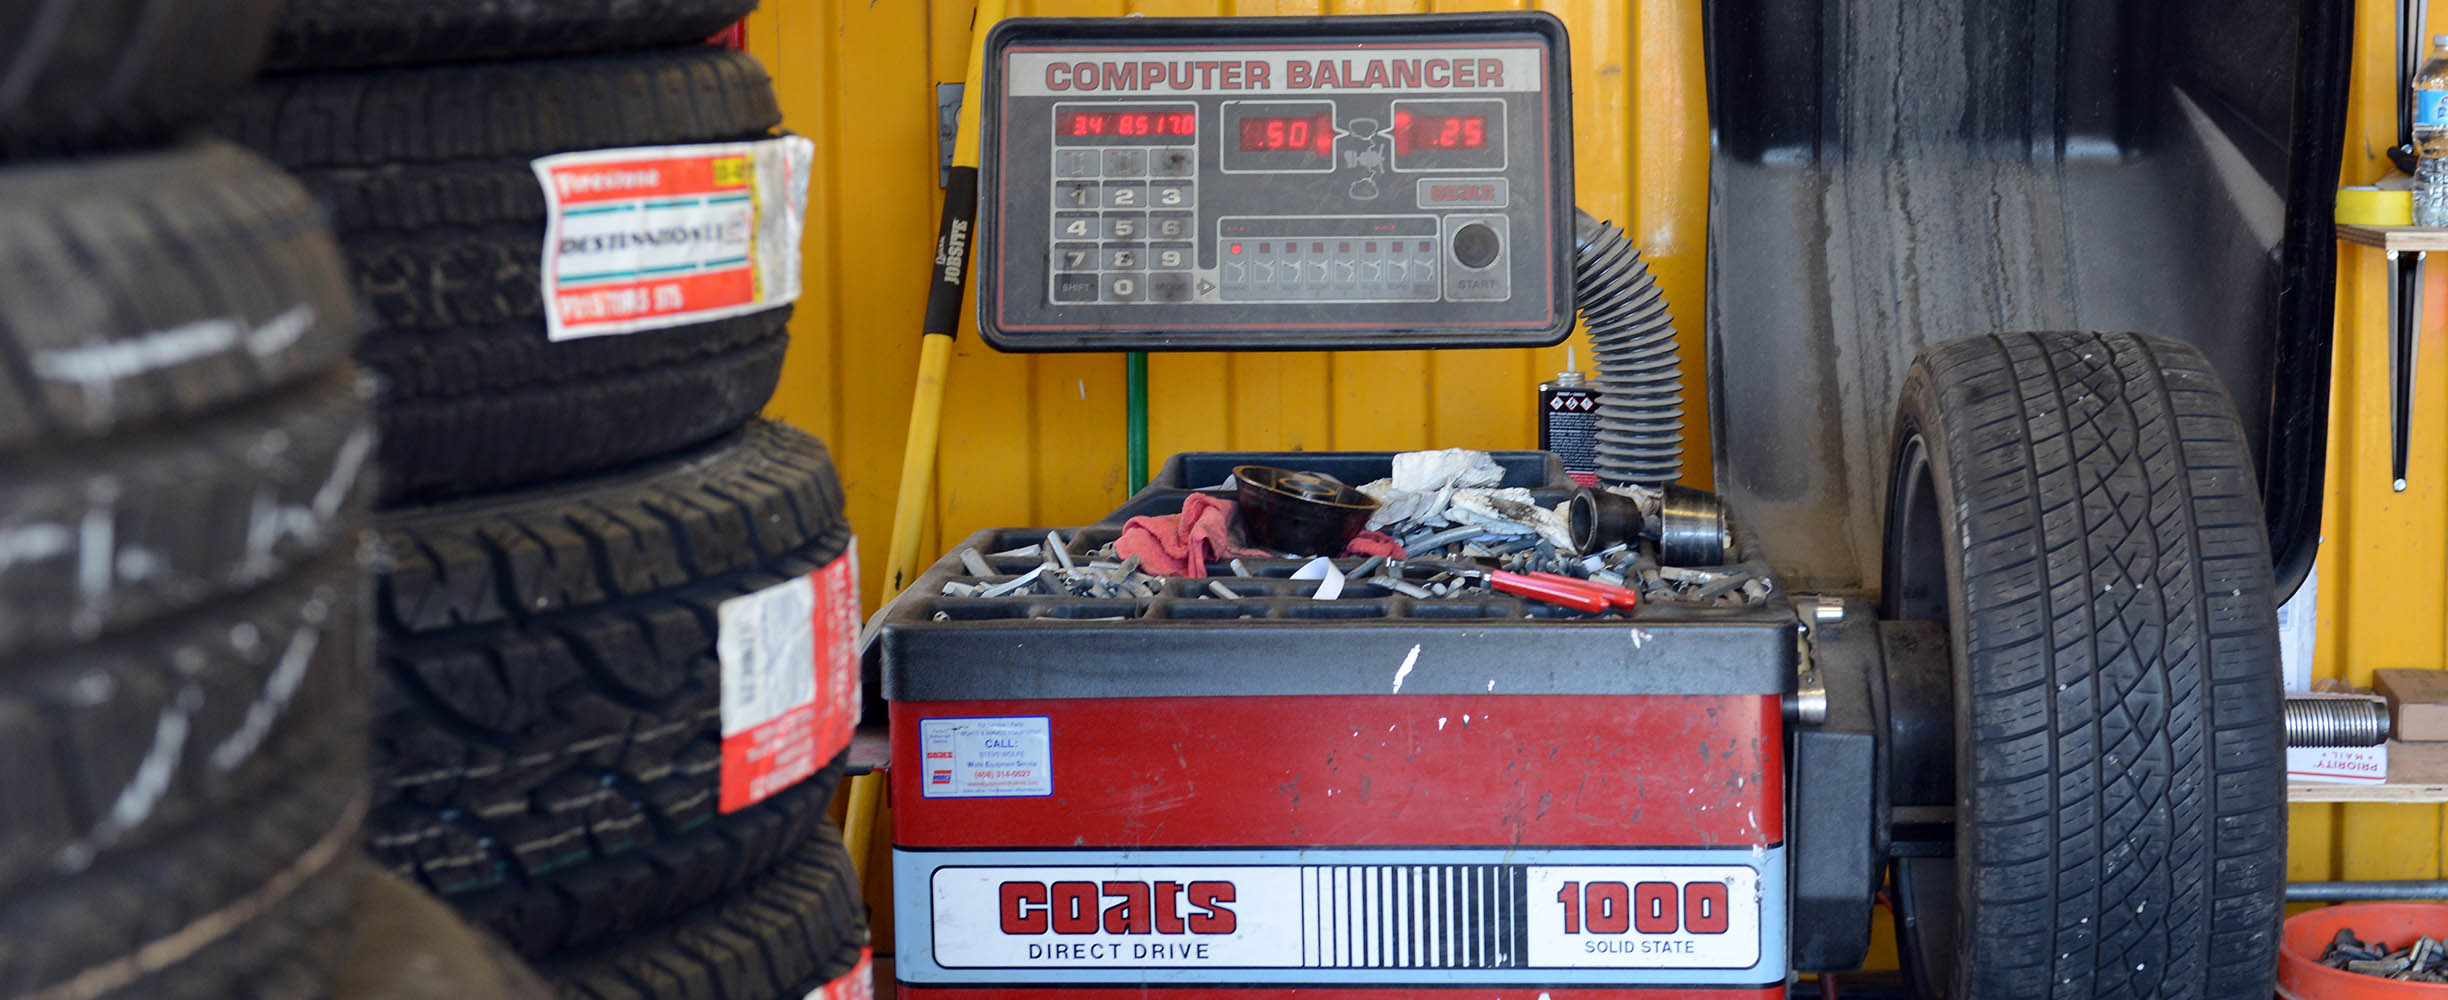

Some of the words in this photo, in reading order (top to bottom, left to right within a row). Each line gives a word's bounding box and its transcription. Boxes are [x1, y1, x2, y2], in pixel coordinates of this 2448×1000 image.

[1046, 60, 1271, 91] COMPUTER
[1286, 58, 1504, 89] BALANCER
[1070, 187, 1087, 206] 1
[1114, 188, 1134, 205] 2
[1161, 188, 1182, 205] 3
[1066, 219, 1088, 236] 4
[1114, 219, 1134, 236] 5
[1161, 219, 1181, 236] 6
[944, 216, 968, 286] JOBSITE
[1066, 250, 1087, 268] 7
[1161, 250, 1182, 267] 9
[1113, 279, 1134, 296] 0
[1458, 279, 1496, 290] START
[984, 739, 1019, 749] CALL:
[2331, 751, 2363, 761] MAIL
[2316, 760, 2379, 772] PRIORITY
[999, 880, 1237, 935] coats
[1557, 881, 1730, 935] 1000
[1028, 944, 1122, 960] DIRECT
[1133, 944, 1210, 959] DRIVE
[1584, 940, 1634, 953] SOLID
[1641, 940, 1695, 953] STATE
